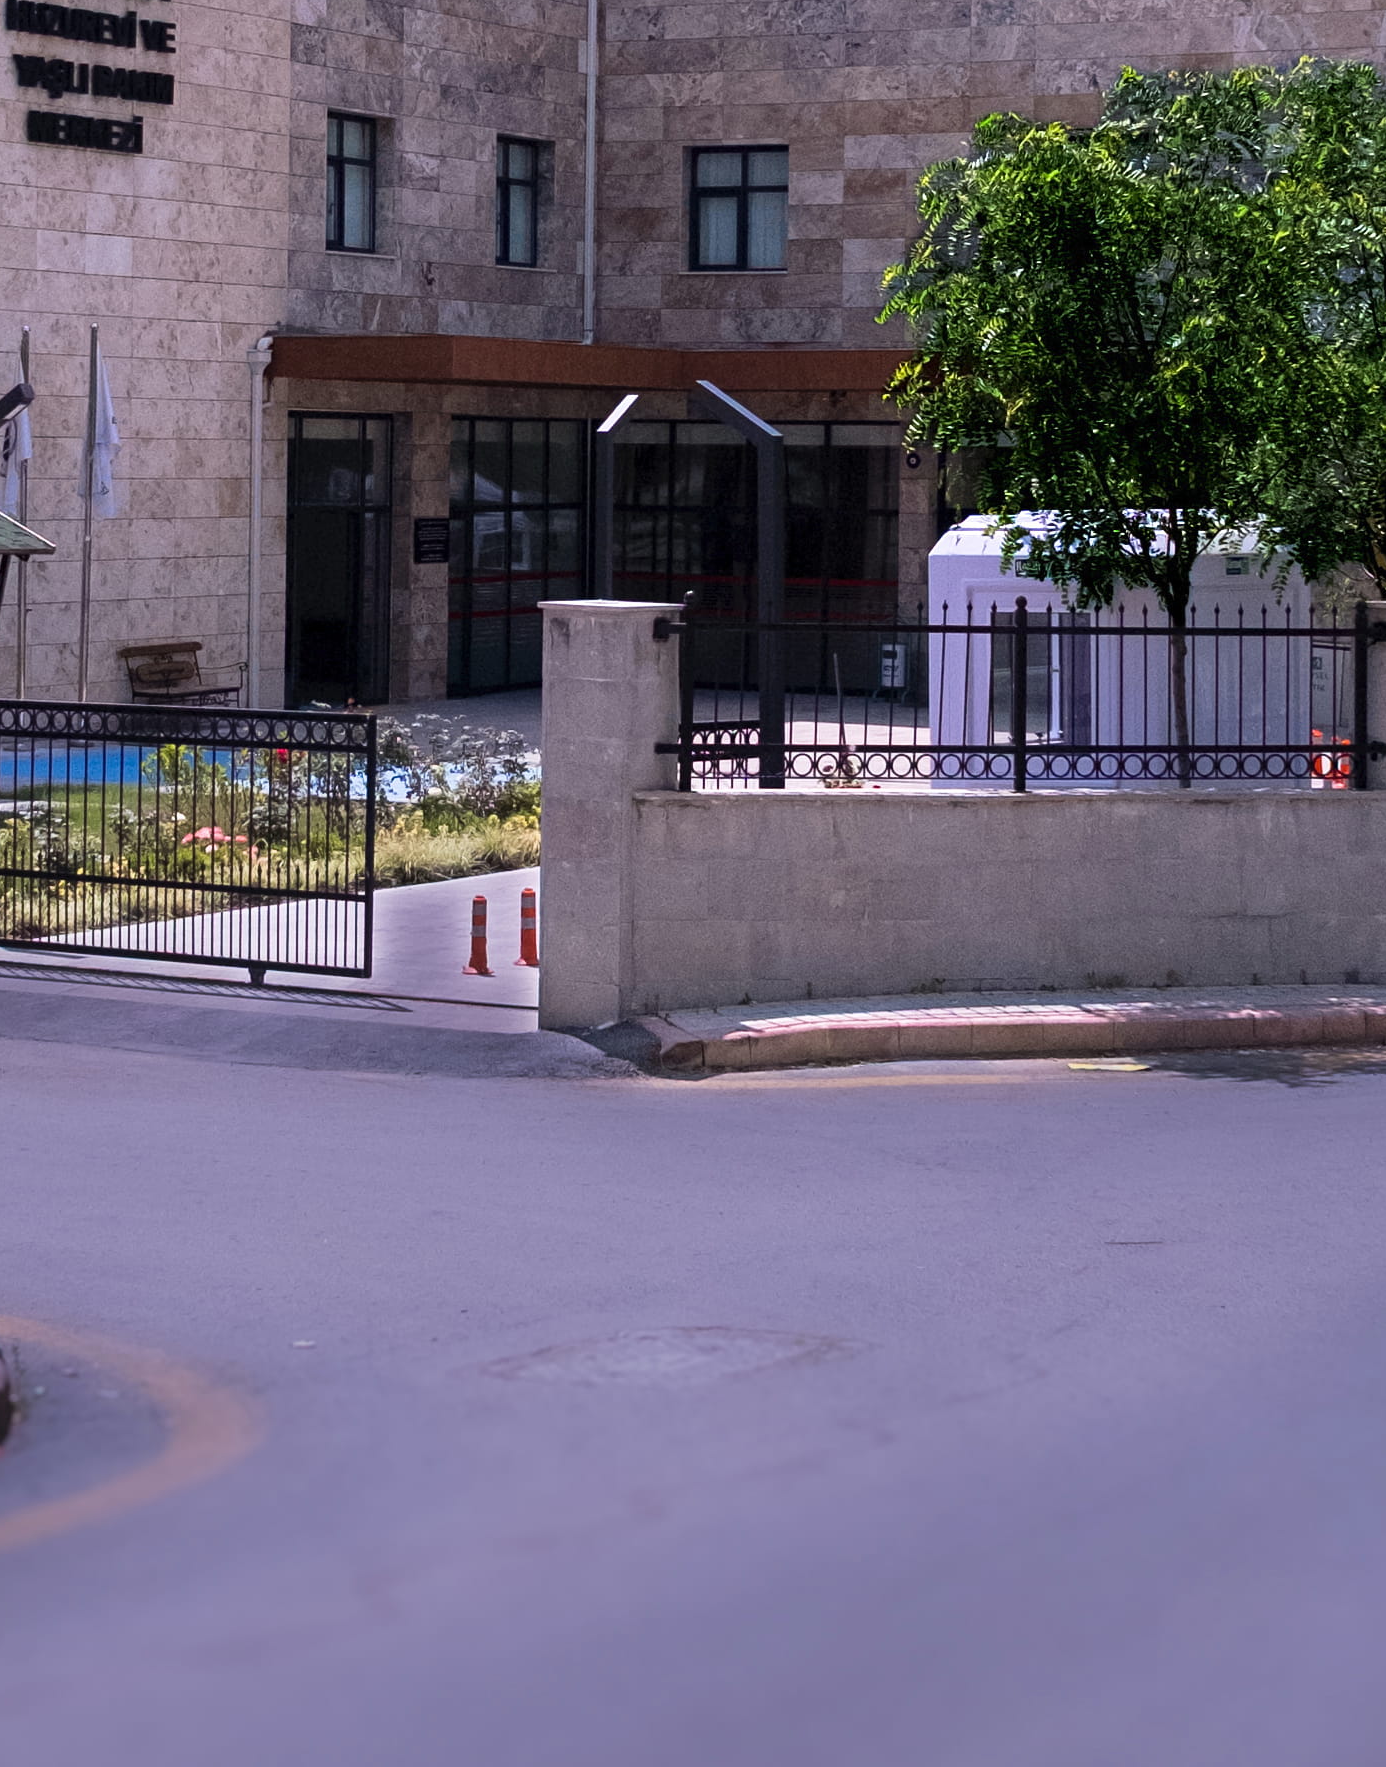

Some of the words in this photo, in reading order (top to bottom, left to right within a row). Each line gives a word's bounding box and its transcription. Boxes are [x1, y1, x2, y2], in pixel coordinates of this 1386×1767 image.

[139, 19, 176, 53] VE
[13, 54, 90, 99] YAŞLI
[26, 110, 143, 154] MERKEZİ
